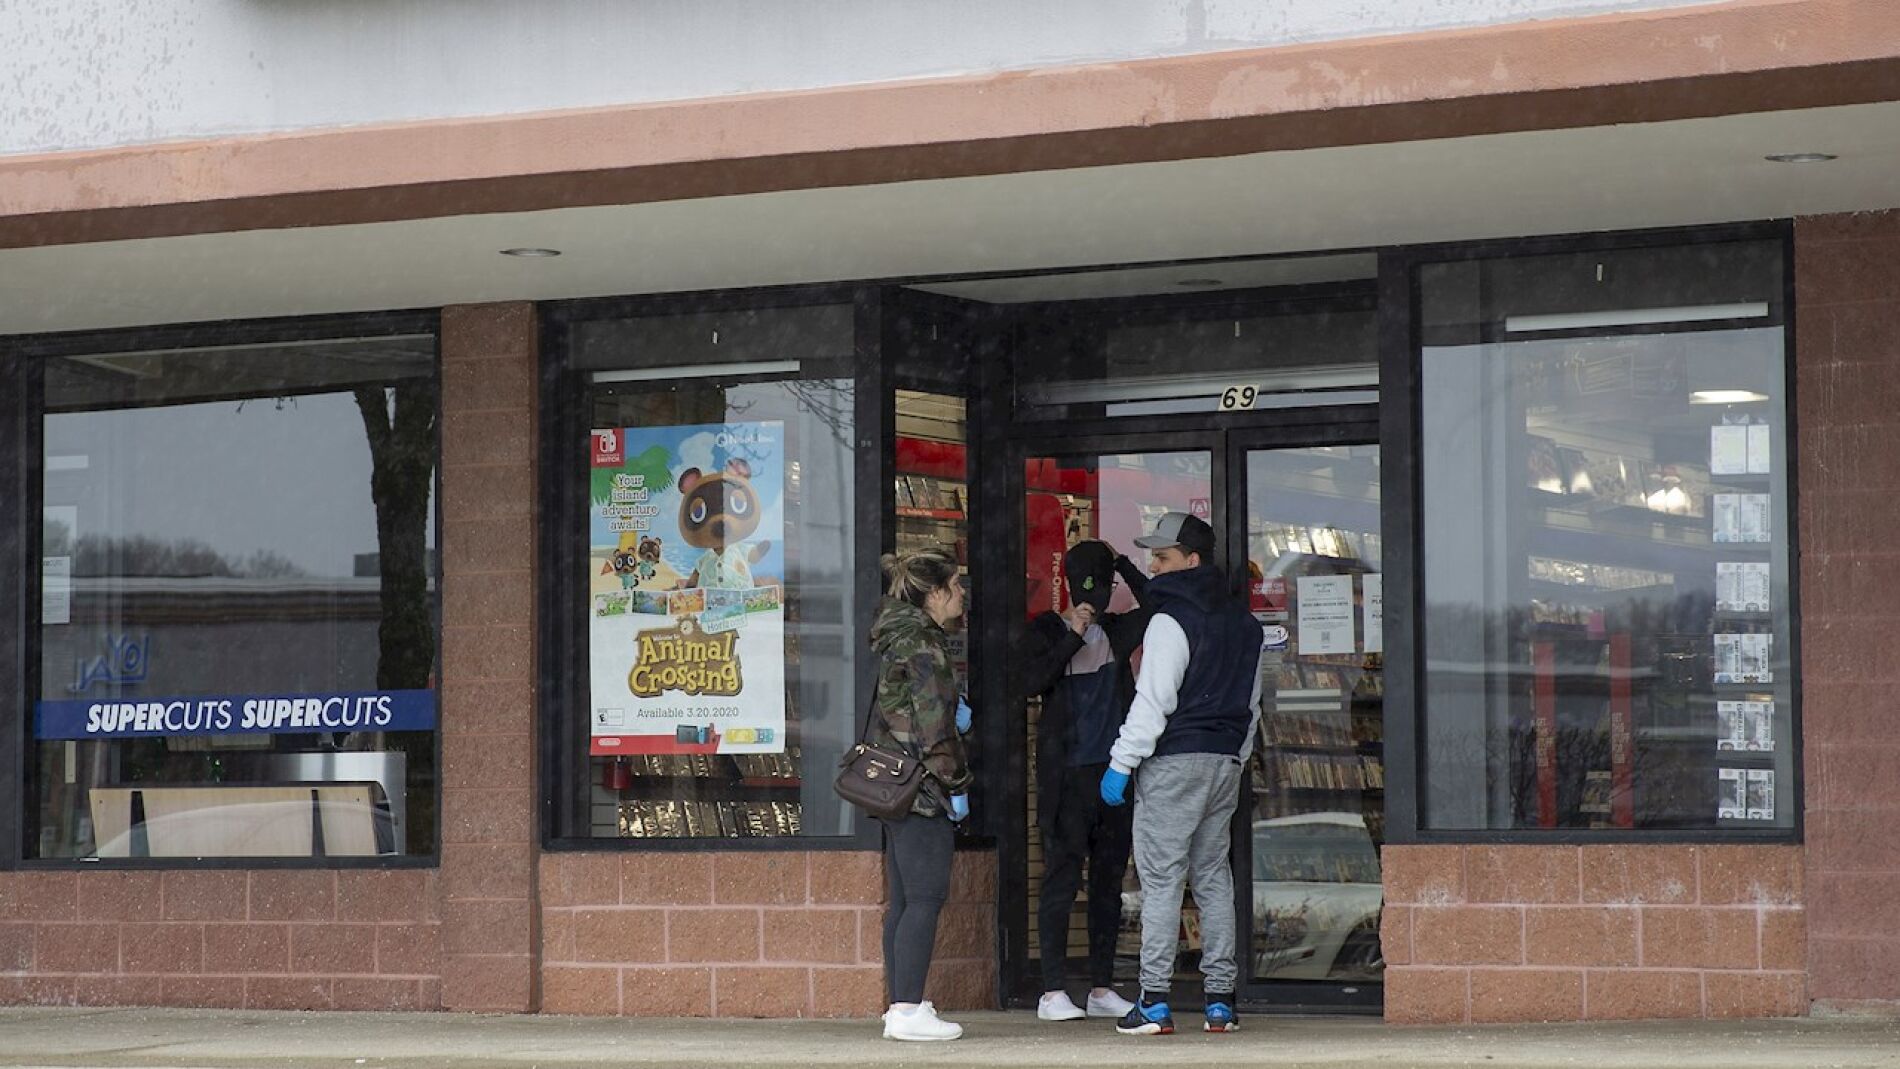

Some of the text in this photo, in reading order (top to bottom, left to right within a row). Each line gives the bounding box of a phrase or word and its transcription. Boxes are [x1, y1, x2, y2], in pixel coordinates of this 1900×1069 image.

[1223, 387, 1255, 408] 69
[618, 475, 644, 486] Your
[612, 488, 647, 500] island
[602, 504, 657, 516] adventure
[1052, 552, 1062, 614] Pre-Owne
[640, 632, 734, 665] Animal
[631, 661, 739, 693] Crossing
[86, 696, 392, 732] SUPERCUTS SUPERCUTS
[637, 706, 739, 718] Available 3.20.2020
